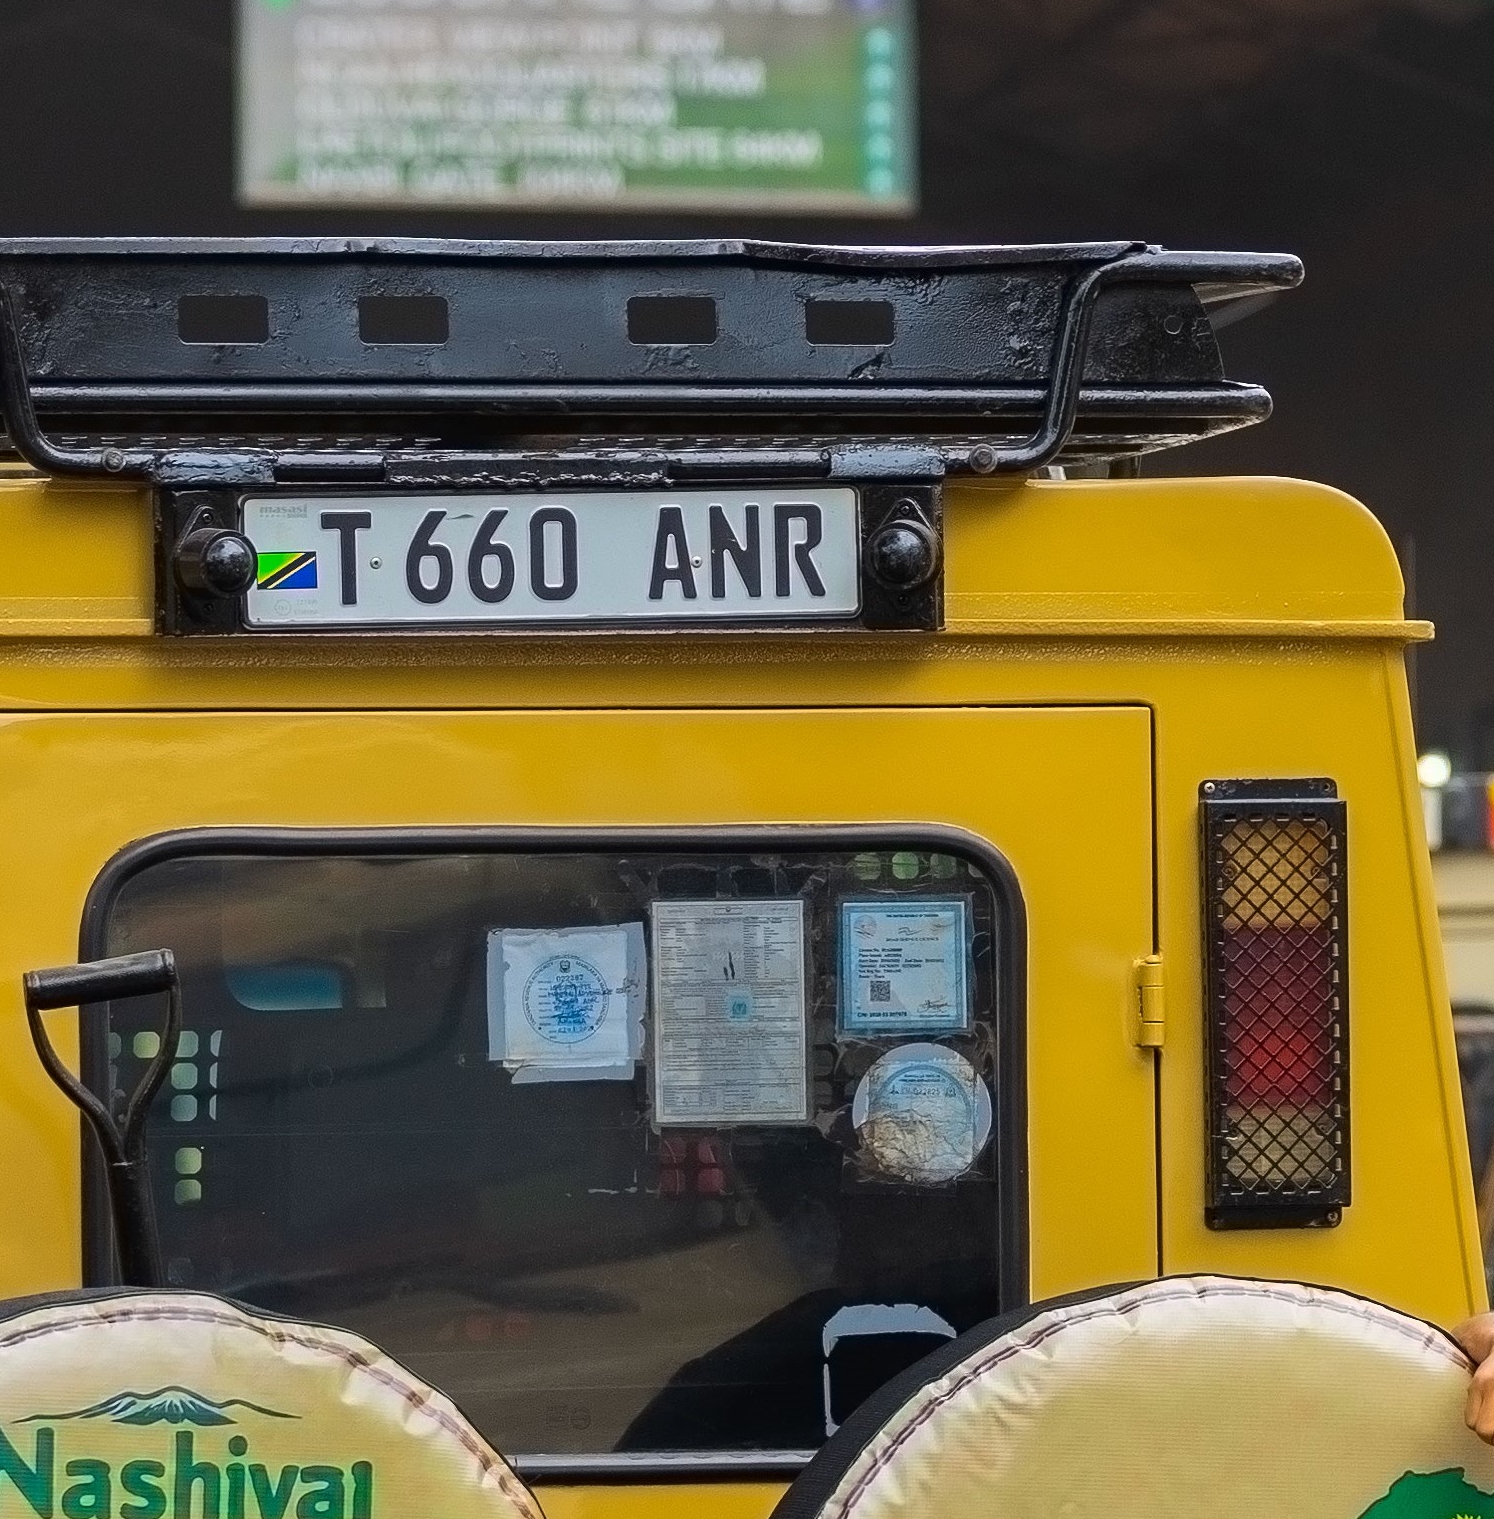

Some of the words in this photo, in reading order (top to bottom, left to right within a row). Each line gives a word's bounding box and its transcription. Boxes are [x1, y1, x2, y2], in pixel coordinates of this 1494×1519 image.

[320, 511, 372, 604] T
[406, 505, 580, 603] 660
[648, 502, 826, 600] ANR
